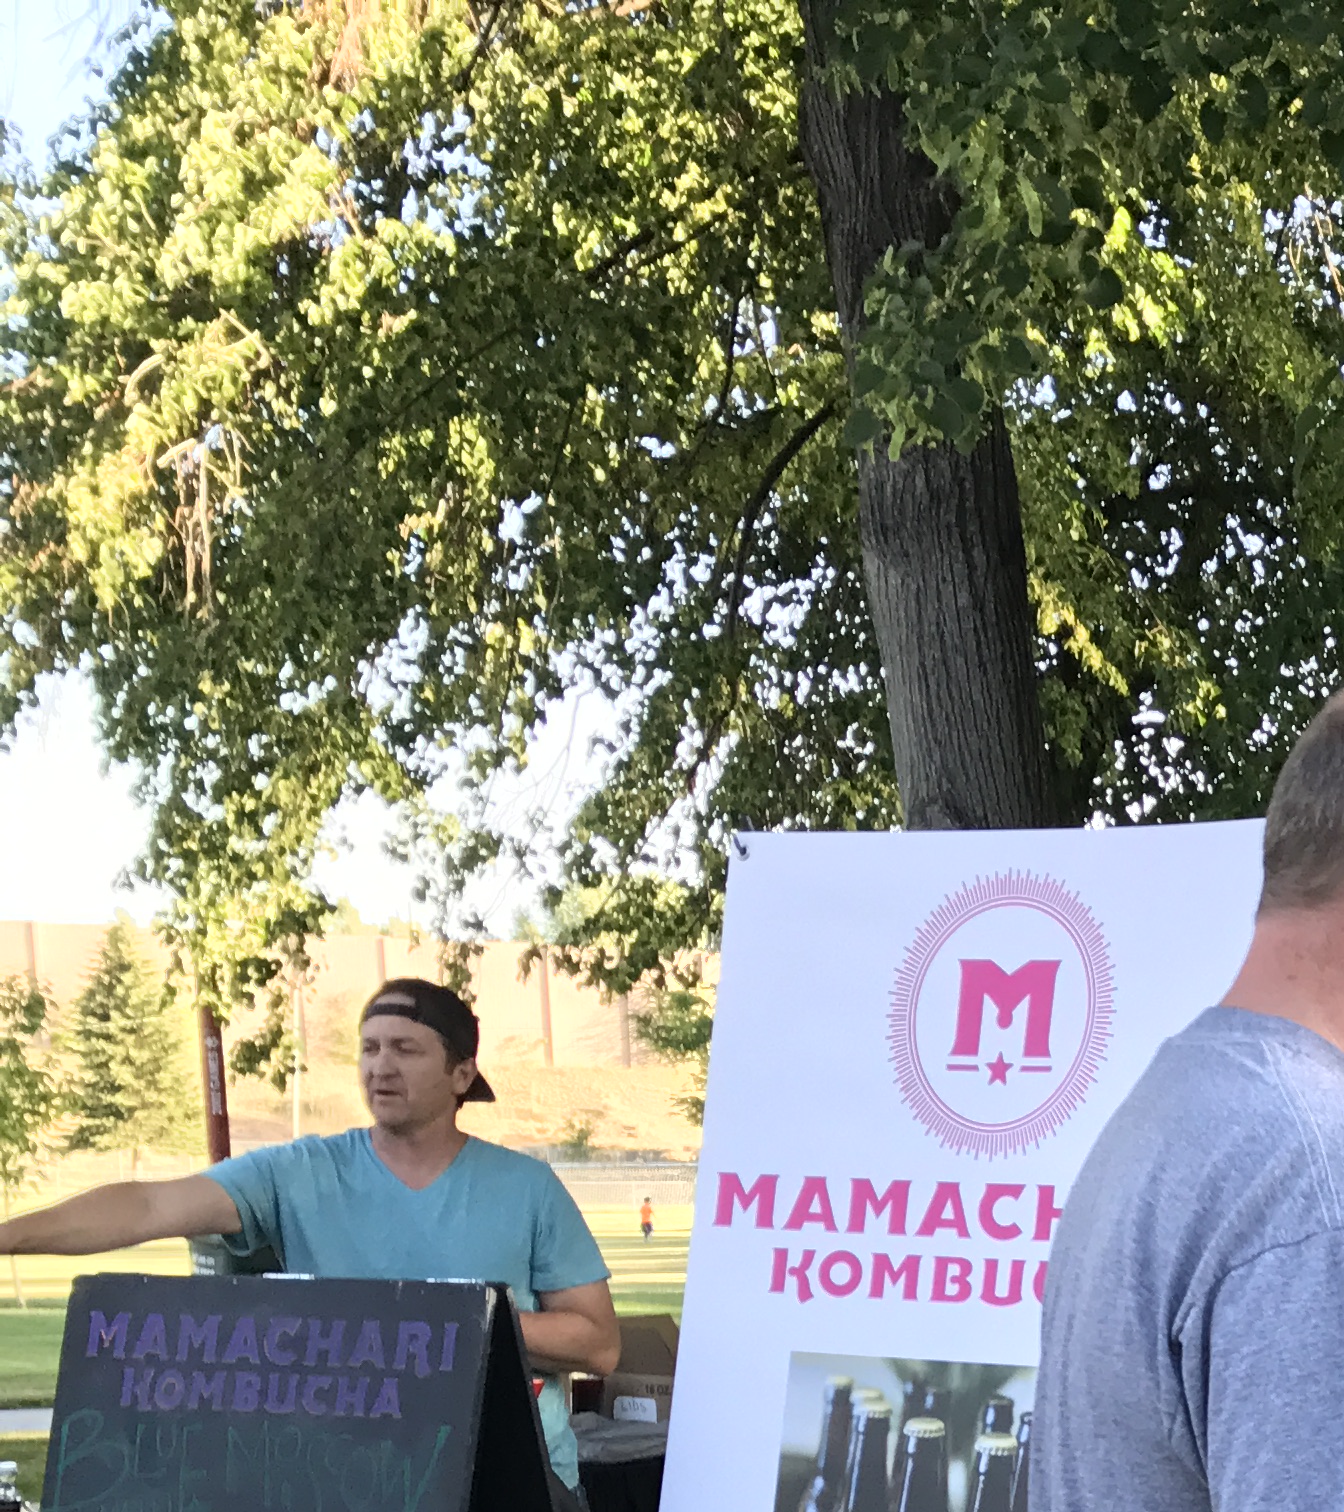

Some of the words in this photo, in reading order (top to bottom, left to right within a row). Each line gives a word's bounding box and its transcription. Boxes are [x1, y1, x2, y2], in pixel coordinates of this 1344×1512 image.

[949, 957, 1062, 1059] M
[86, 1310, 457, 1378] MAMACHARI
[119, 1368, 402, 1418] KOMBUCHA
